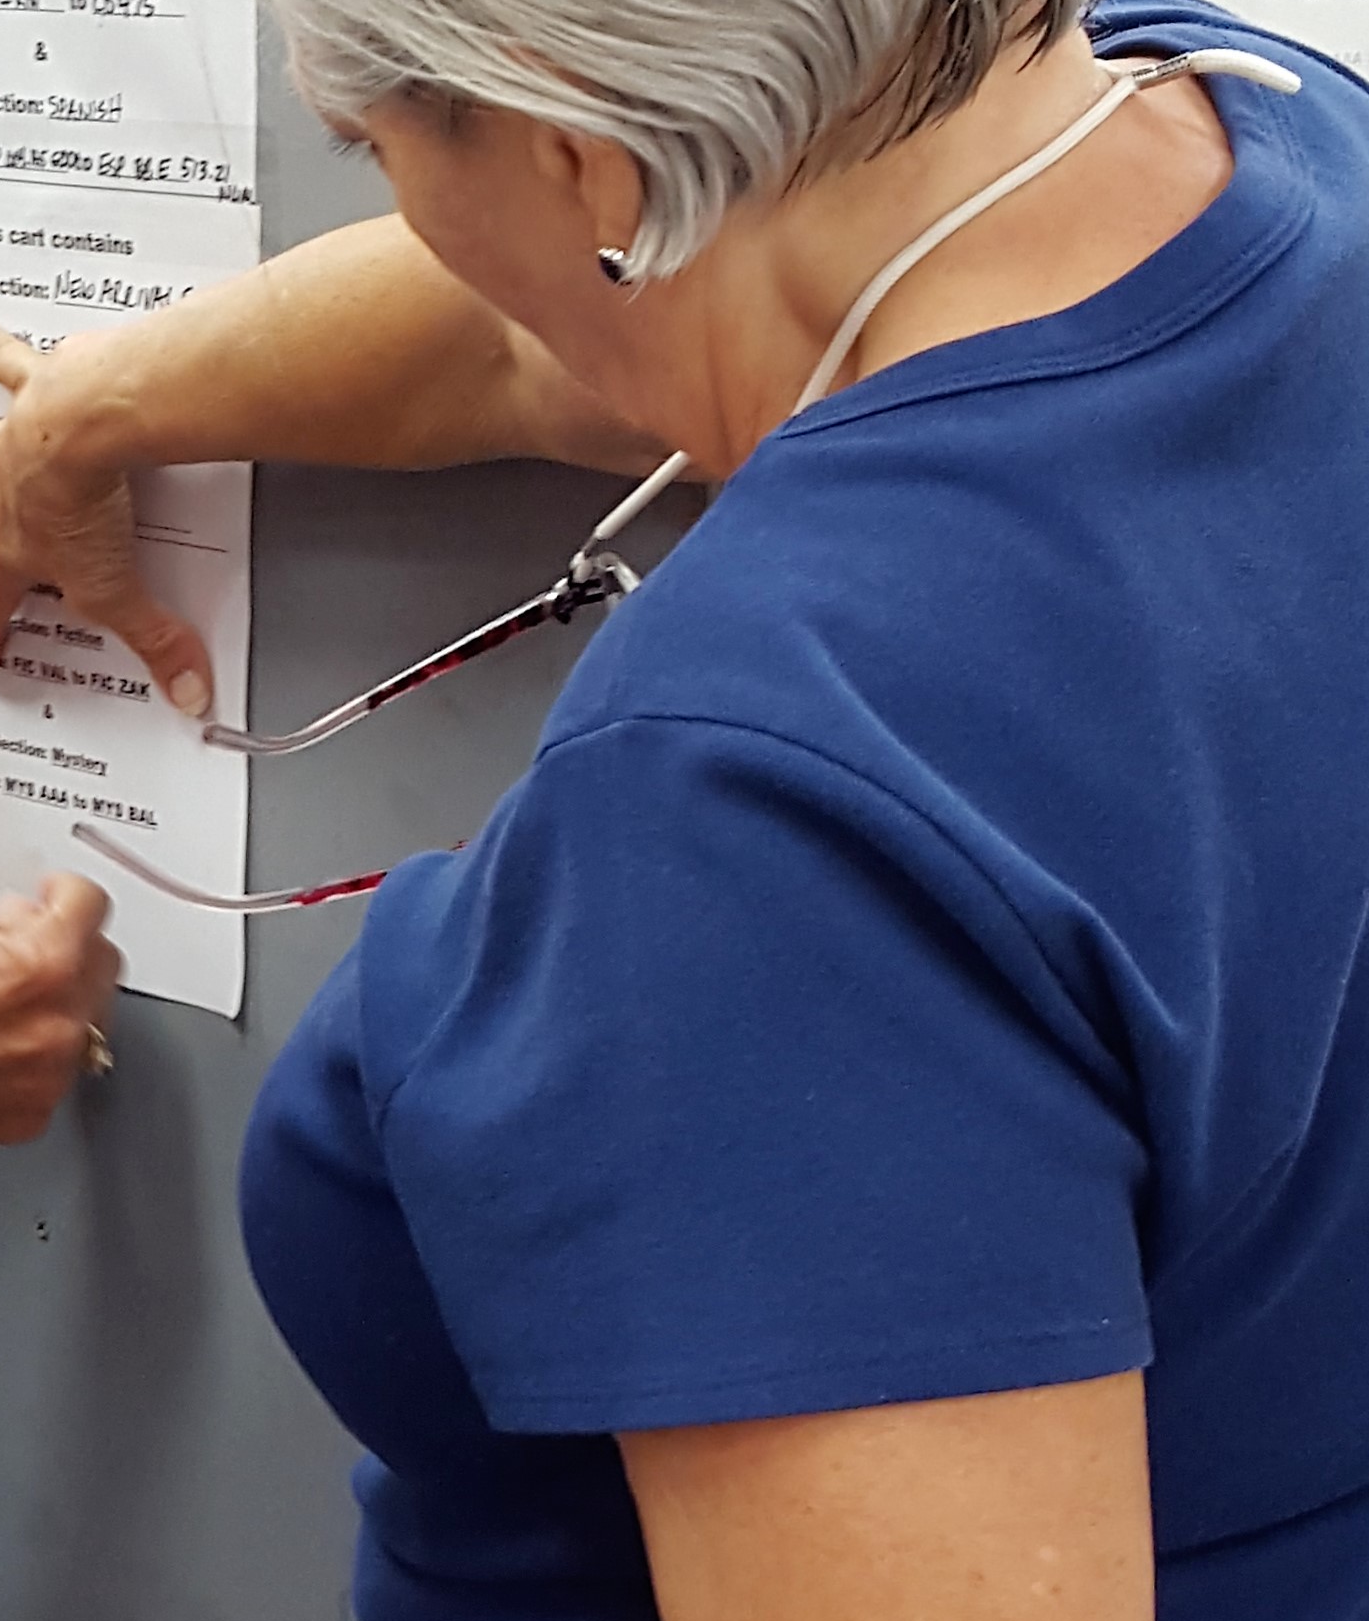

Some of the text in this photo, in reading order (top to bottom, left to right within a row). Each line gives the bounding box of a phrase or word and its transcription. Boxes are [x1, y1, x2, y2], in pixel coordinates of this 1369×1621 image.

[34, 42, 48, 61] &
[9, 227, 44, 247] cart
[51, 231, 135, 255] contains
[55, 623, 105, 646] Fiction
[72, 669, 86, 685] to
[52, 748, 109, 776] Mystery
[73, 792, 88, 810] to
